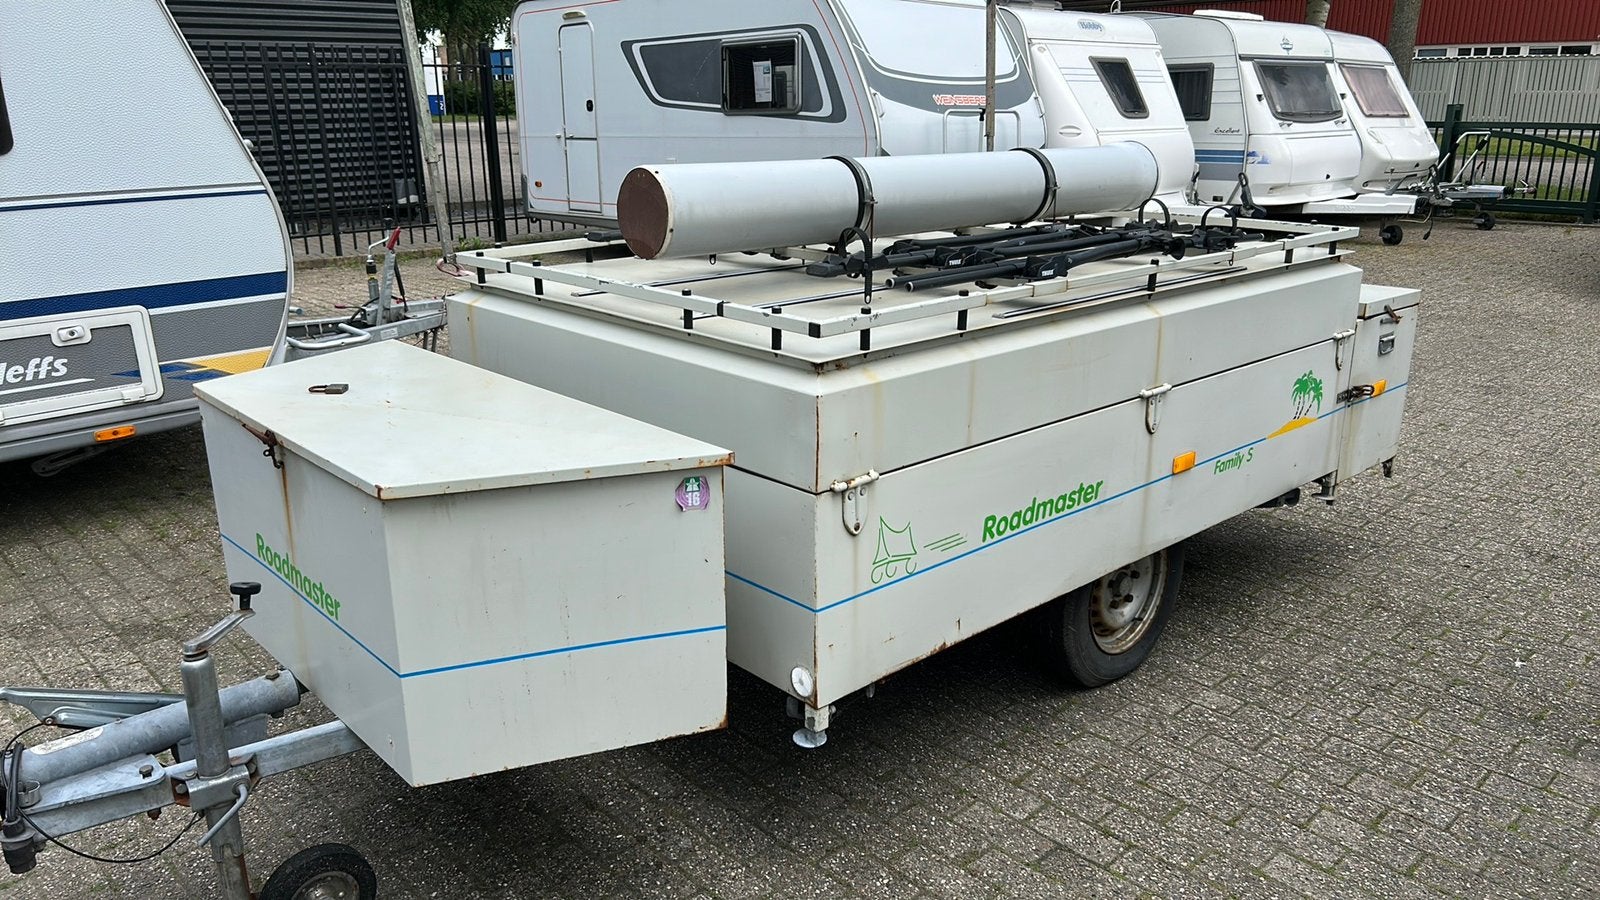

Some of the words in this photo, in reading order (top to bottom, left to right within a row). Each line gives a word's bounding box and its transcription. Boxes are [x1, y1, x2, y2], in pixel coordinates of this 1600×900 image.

[1213, 451, 1245, 475] Family
[1246, 446, 1254, 462] S
[685, 491, 701, 506] 16
[982, 479, 1104, 543] Roadmaster
[255, 532, 342, 621] Roadmaster
